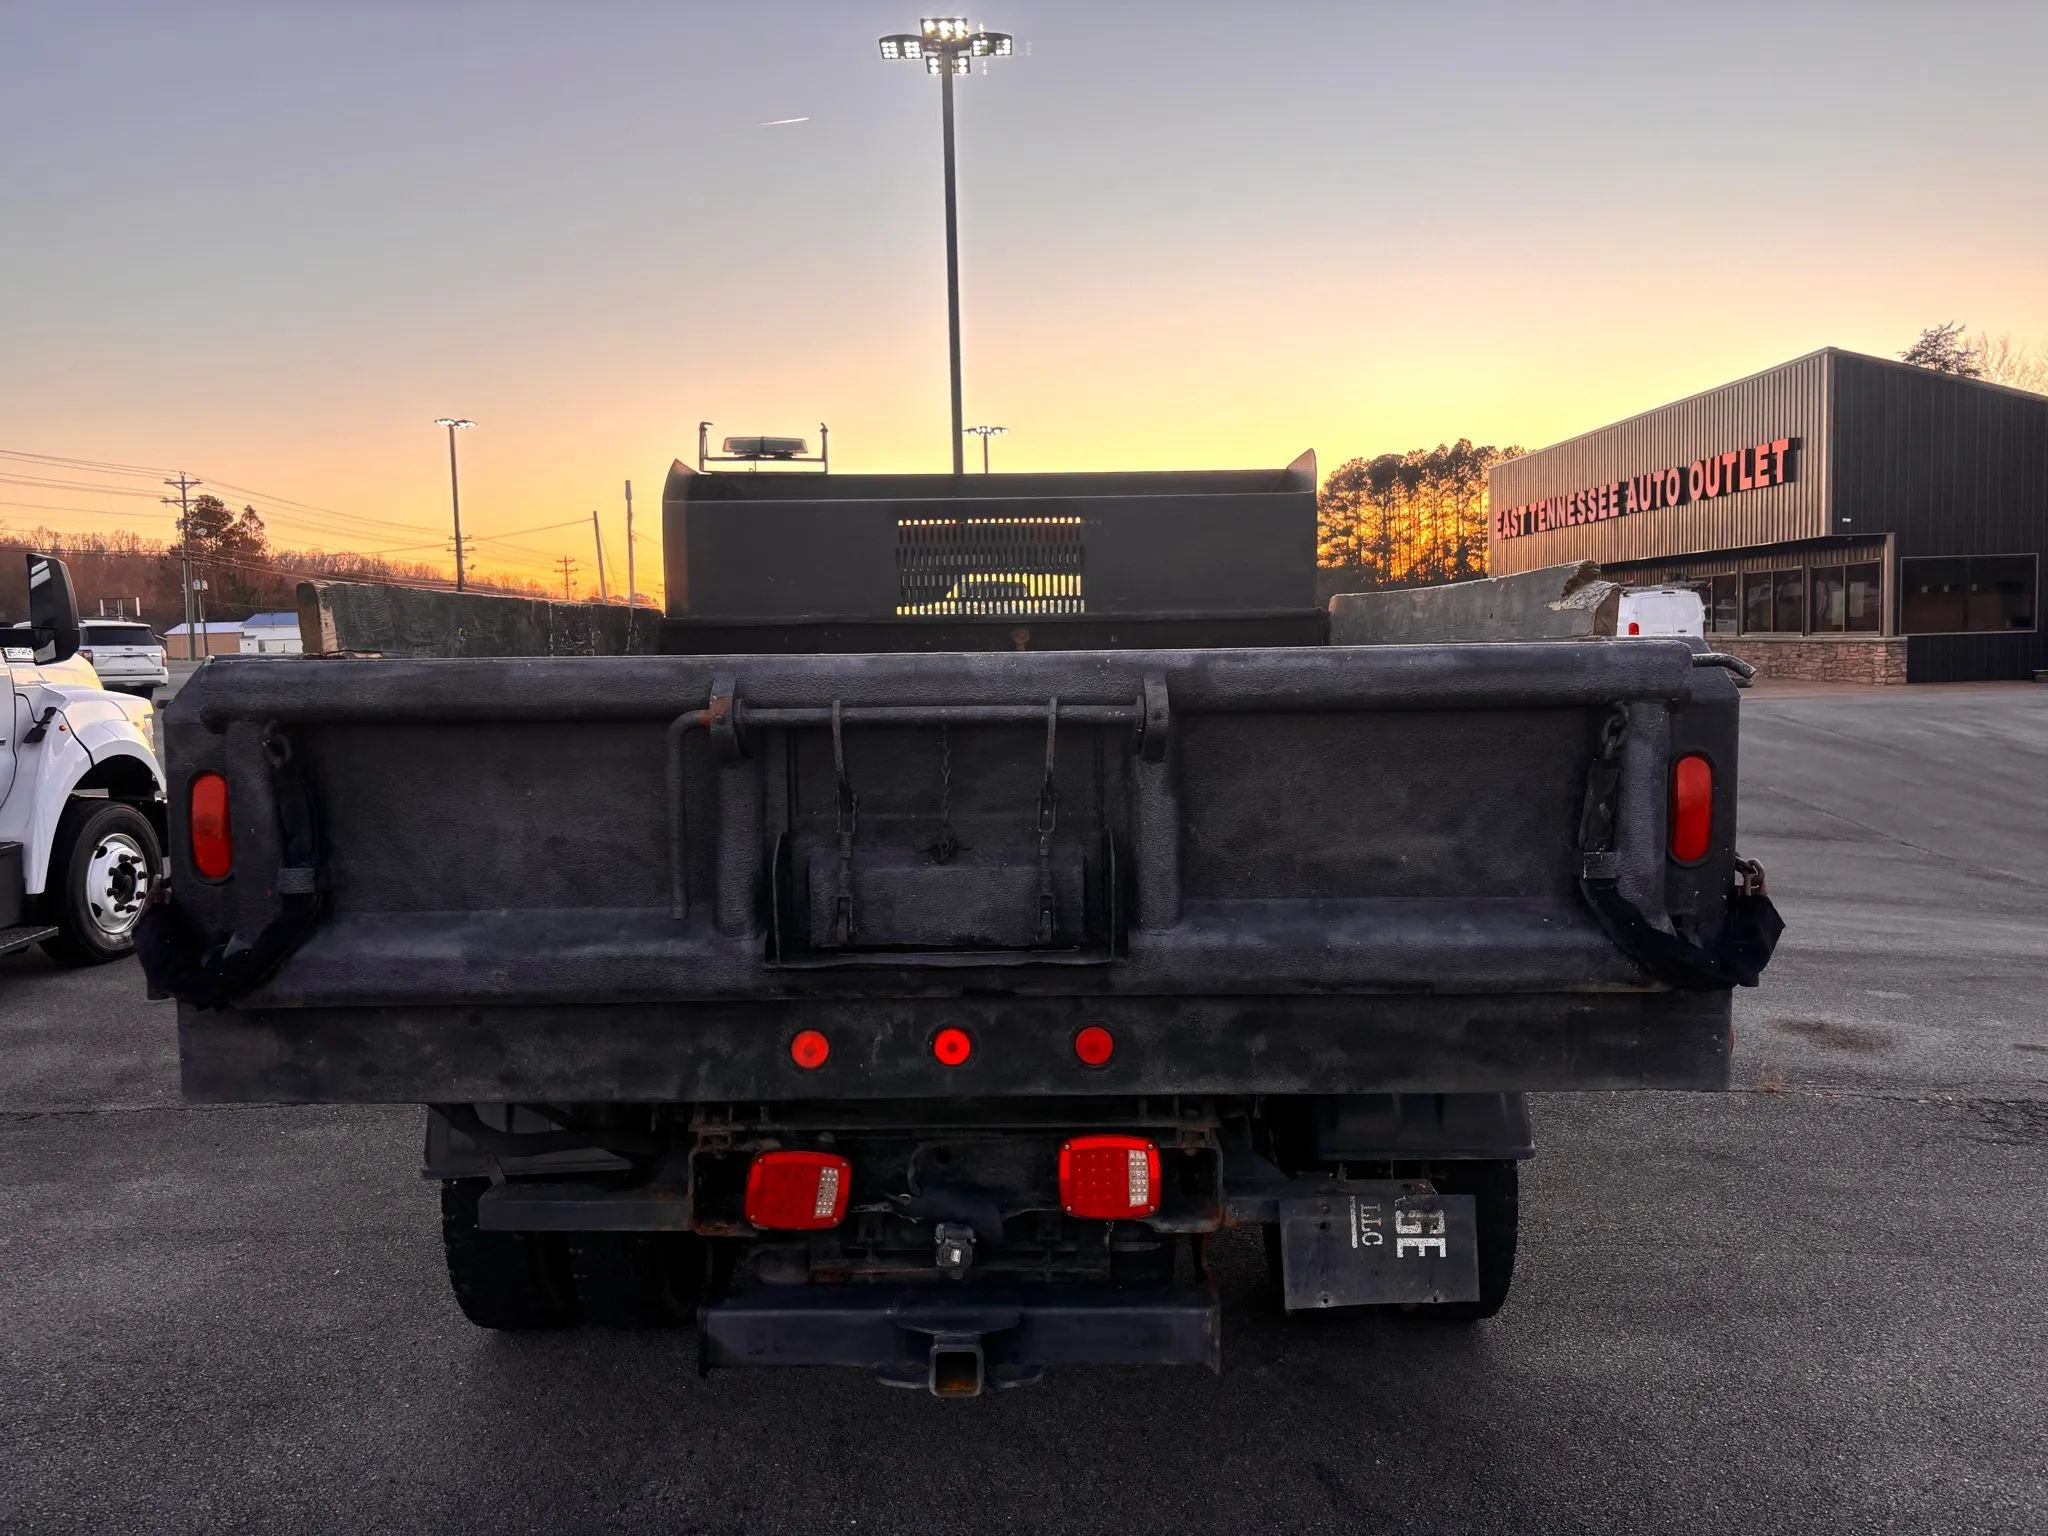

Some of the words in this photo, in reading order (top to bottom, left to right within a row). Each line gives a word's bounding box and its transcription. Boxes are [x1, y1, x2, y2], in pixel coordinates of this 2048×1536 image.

[1496, 505, 1526, 539] EAST
[1529, 483, 1619, 533] TENNESSEE
[1626, 466, 1680, 514] AUTO
[1688, 438, 1788, 500] OUTLET
[1360, 1203, 1383, 1246] LLC
[1395, 1195, 1446, 1258] GE
